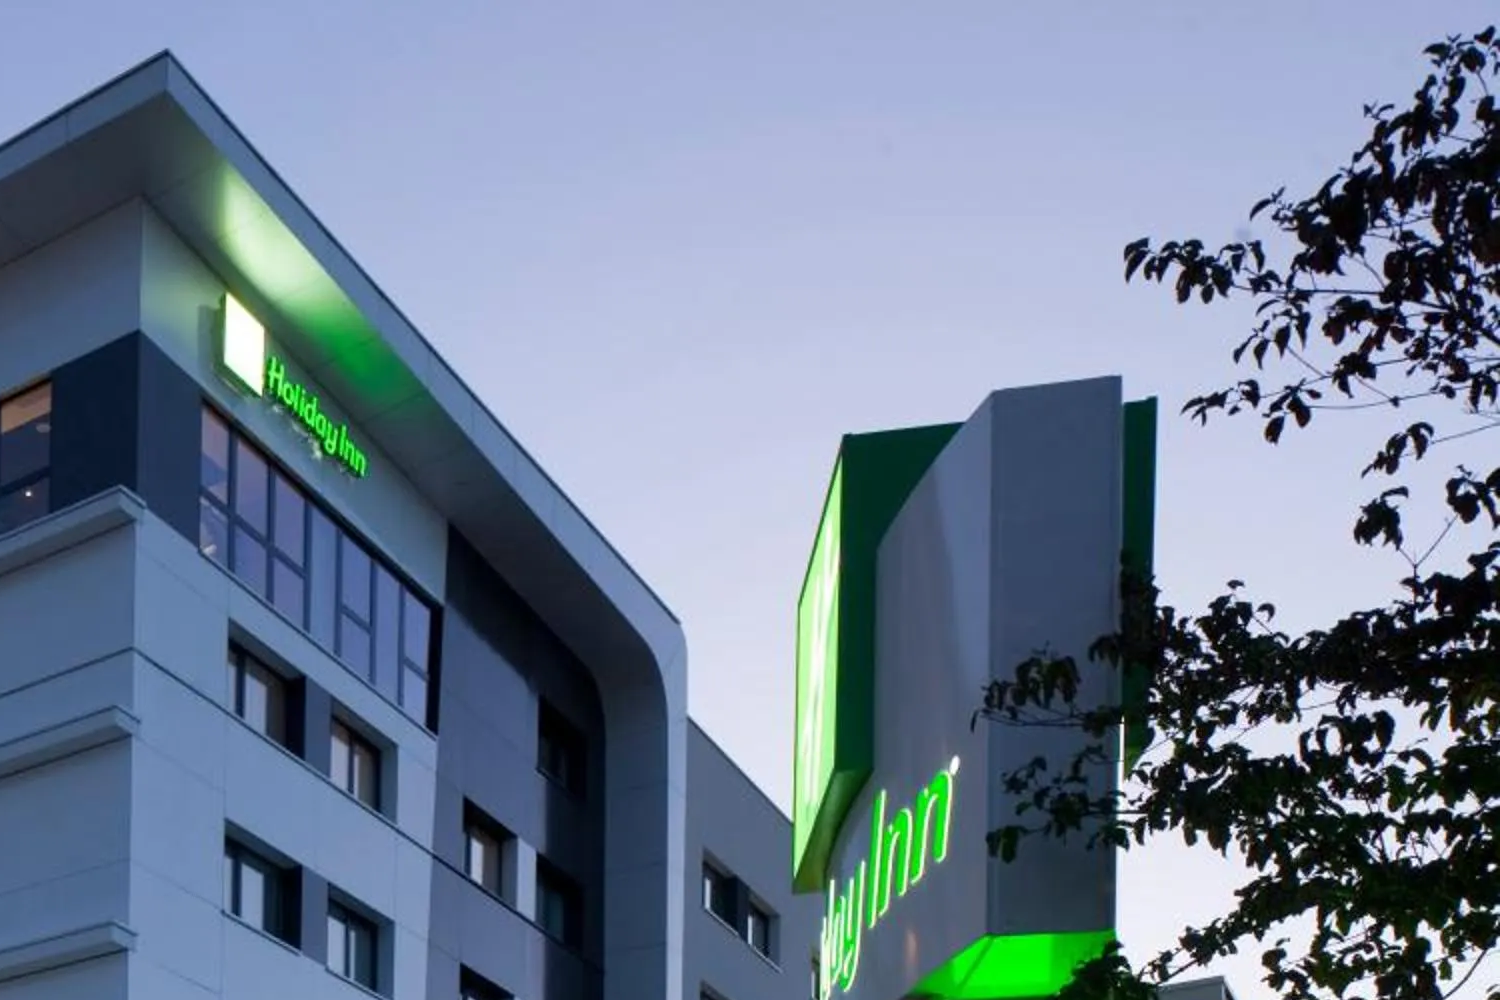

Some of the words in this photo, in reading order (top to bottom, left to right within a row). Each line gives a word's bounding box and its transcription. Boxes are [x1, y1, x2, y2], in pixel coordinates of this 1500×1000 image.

[267, 356, 338, 454] Holiday
[338, 425, 367, 478] Inn
[866, 769, 953, 929] Inn
